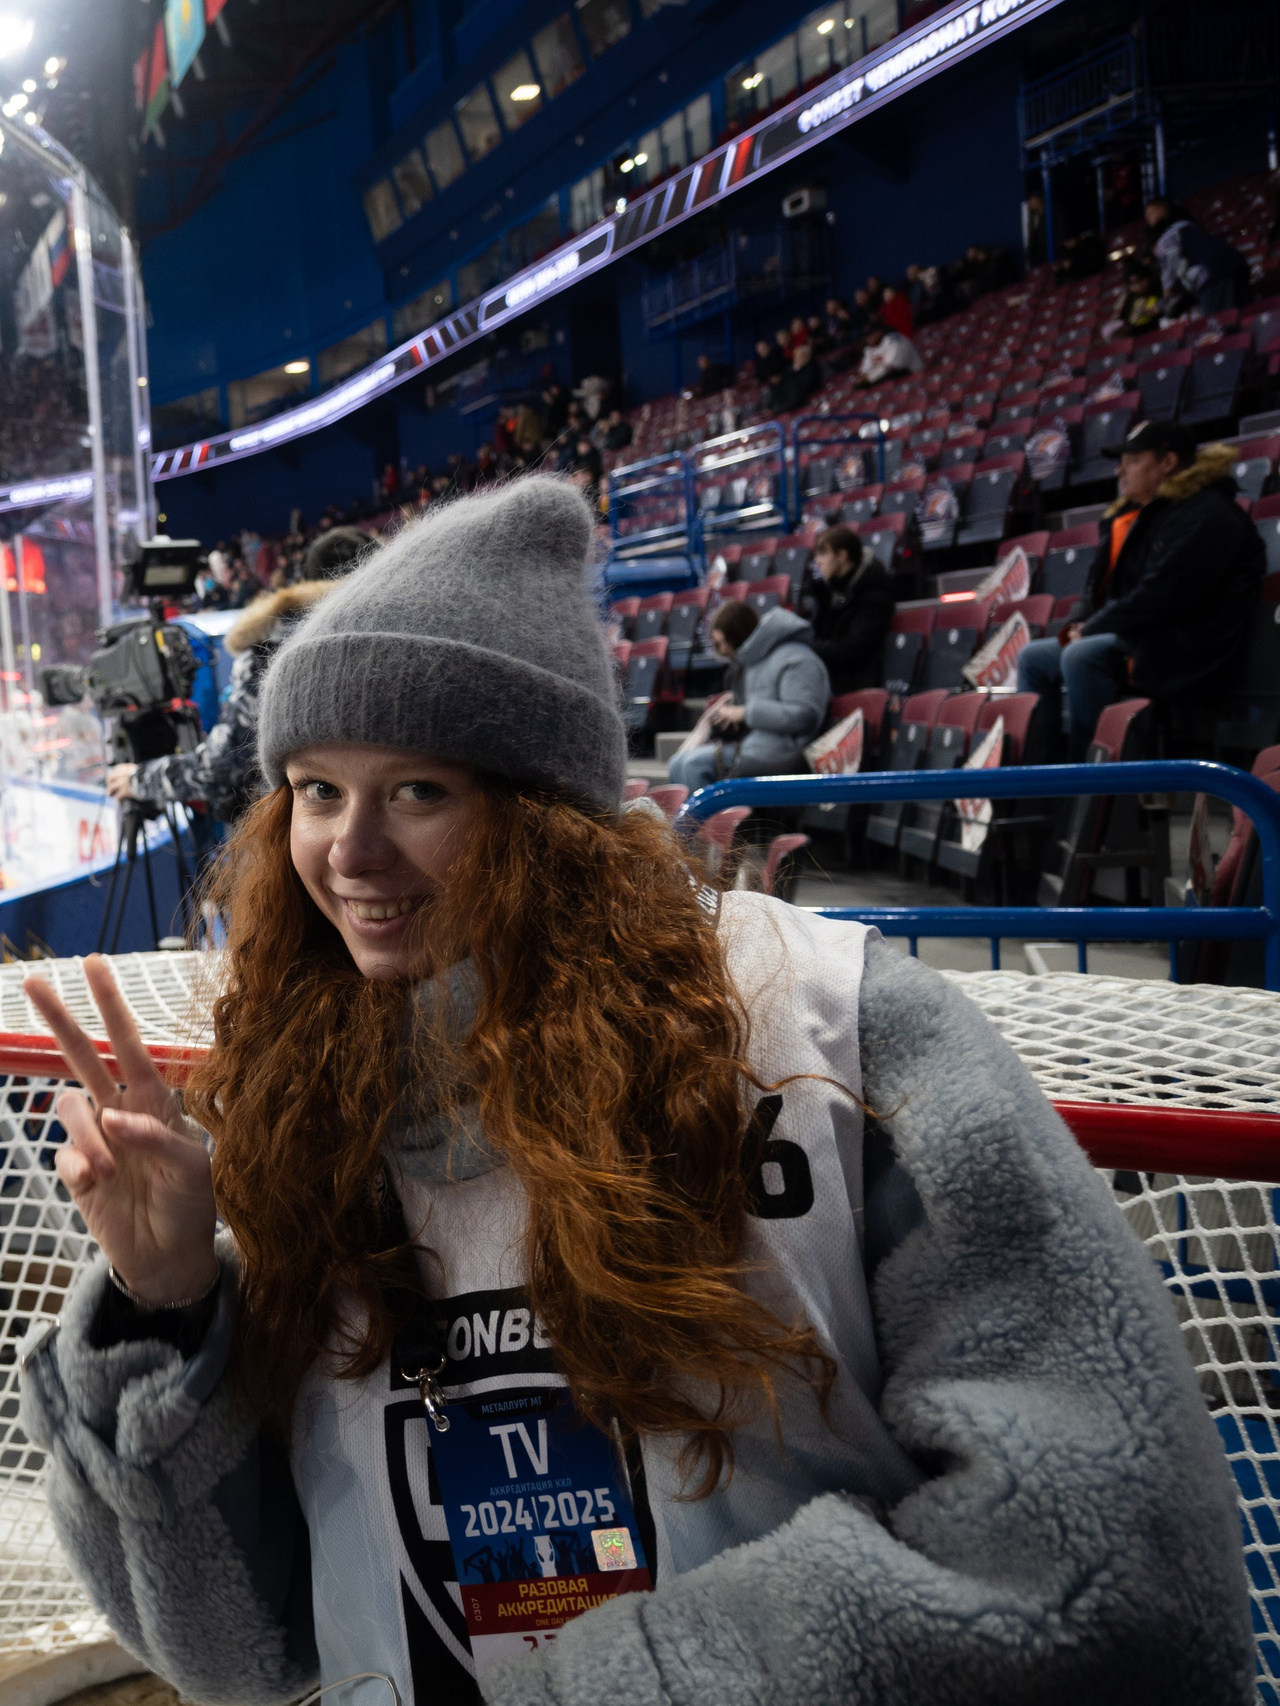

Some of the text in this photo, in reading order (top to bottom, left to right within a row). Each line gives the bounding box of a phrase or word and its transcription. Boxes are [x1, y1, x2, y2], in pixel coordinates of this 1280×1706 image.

[481, 1395, 543, 1414] МЕТАЛЛУРГ МГ
[489, 1418, 549, 1479] TV
[489, 1477, 573, 1497] АККРЕДИТАЦИЯ КХЛ
[518, 1577, 590, 1599] РАЗОВАЯ
[472, 1597, 483, 1622] 0307
[535, 1618, 550, 1627] ONE
[551, 1616, 564, 1626] DAY
